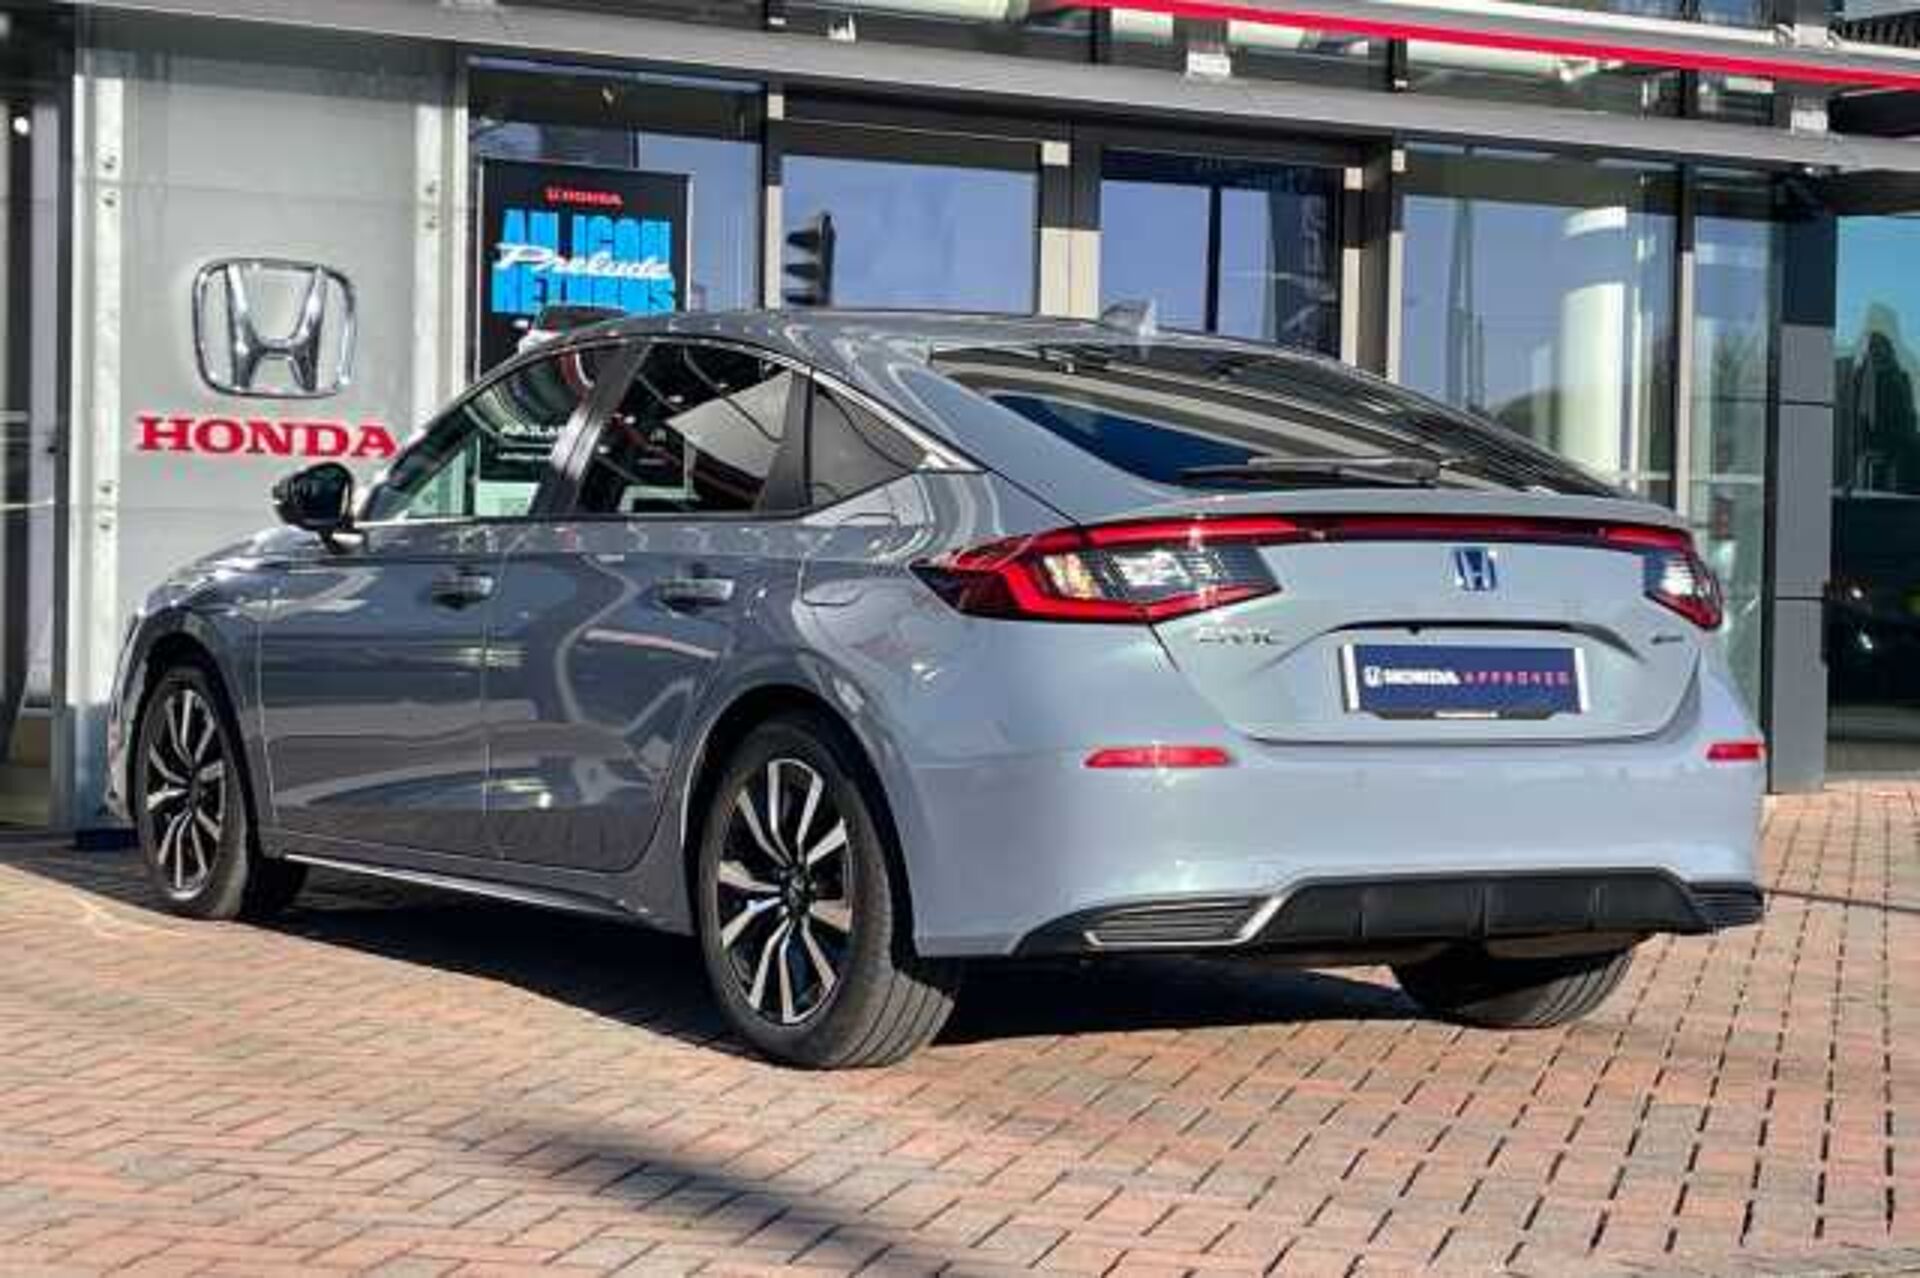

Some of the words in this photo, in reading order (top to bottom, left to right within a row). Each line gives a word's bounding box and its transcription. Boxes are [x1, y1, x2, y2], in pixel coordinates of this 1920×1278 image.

[496, 242, 670, 279] Prelude
[137, 416, 397, 457] HONDA
[1384, 668, 1460, 685] HONDA
[1464, 671, 1571, 686] APPROVED
